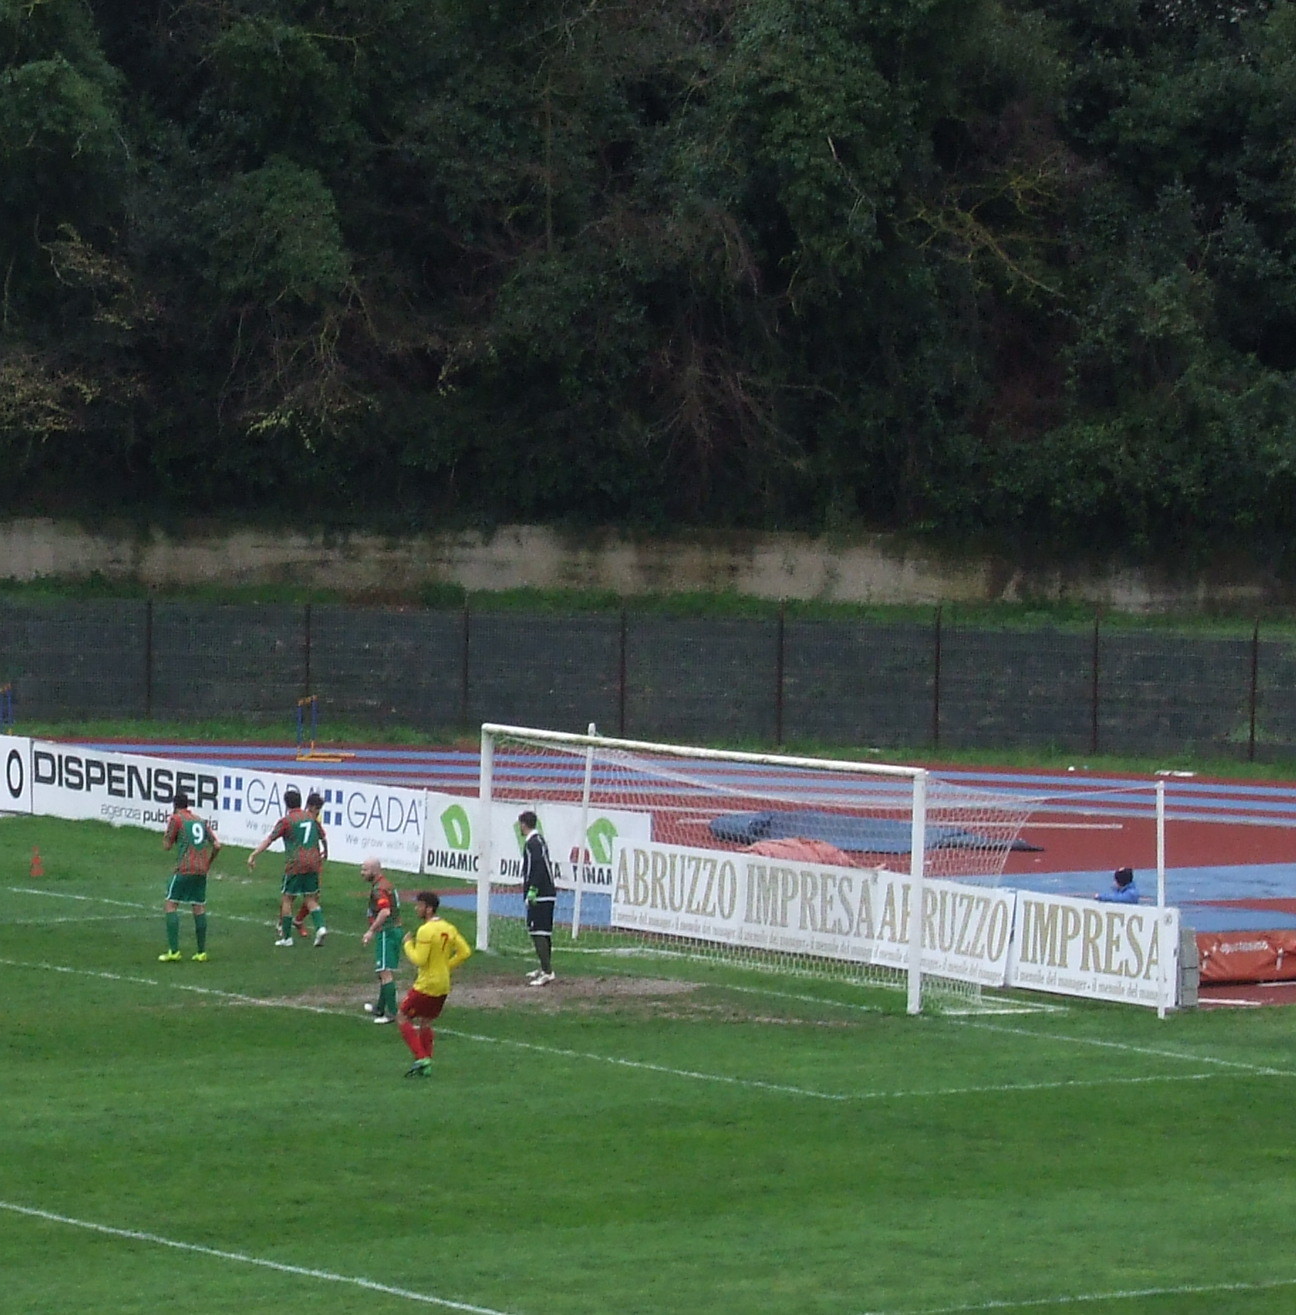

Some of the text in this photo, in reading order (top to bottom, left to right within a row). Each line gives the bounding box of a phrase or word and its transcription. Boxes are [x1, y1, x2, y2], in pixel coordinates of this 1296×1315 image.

[33, 750, 219, 810] DISPENSER
[100, 803, 141, 820] agenzia
[346, 791, 421, 836] GADA
[191, 822, 204, 845] 9
[299, 821, 313, 844] 7
[360, 837, 386, 849] grow
[426, 849, 480, 873] DINAMIC
[613, 848, 738, 920] ABRUZZO
[745, 862, 876, 940] IMPRESA
[439, 932, 450, 951] 7
[1019, 900, 1169, 982] IMPRESA
